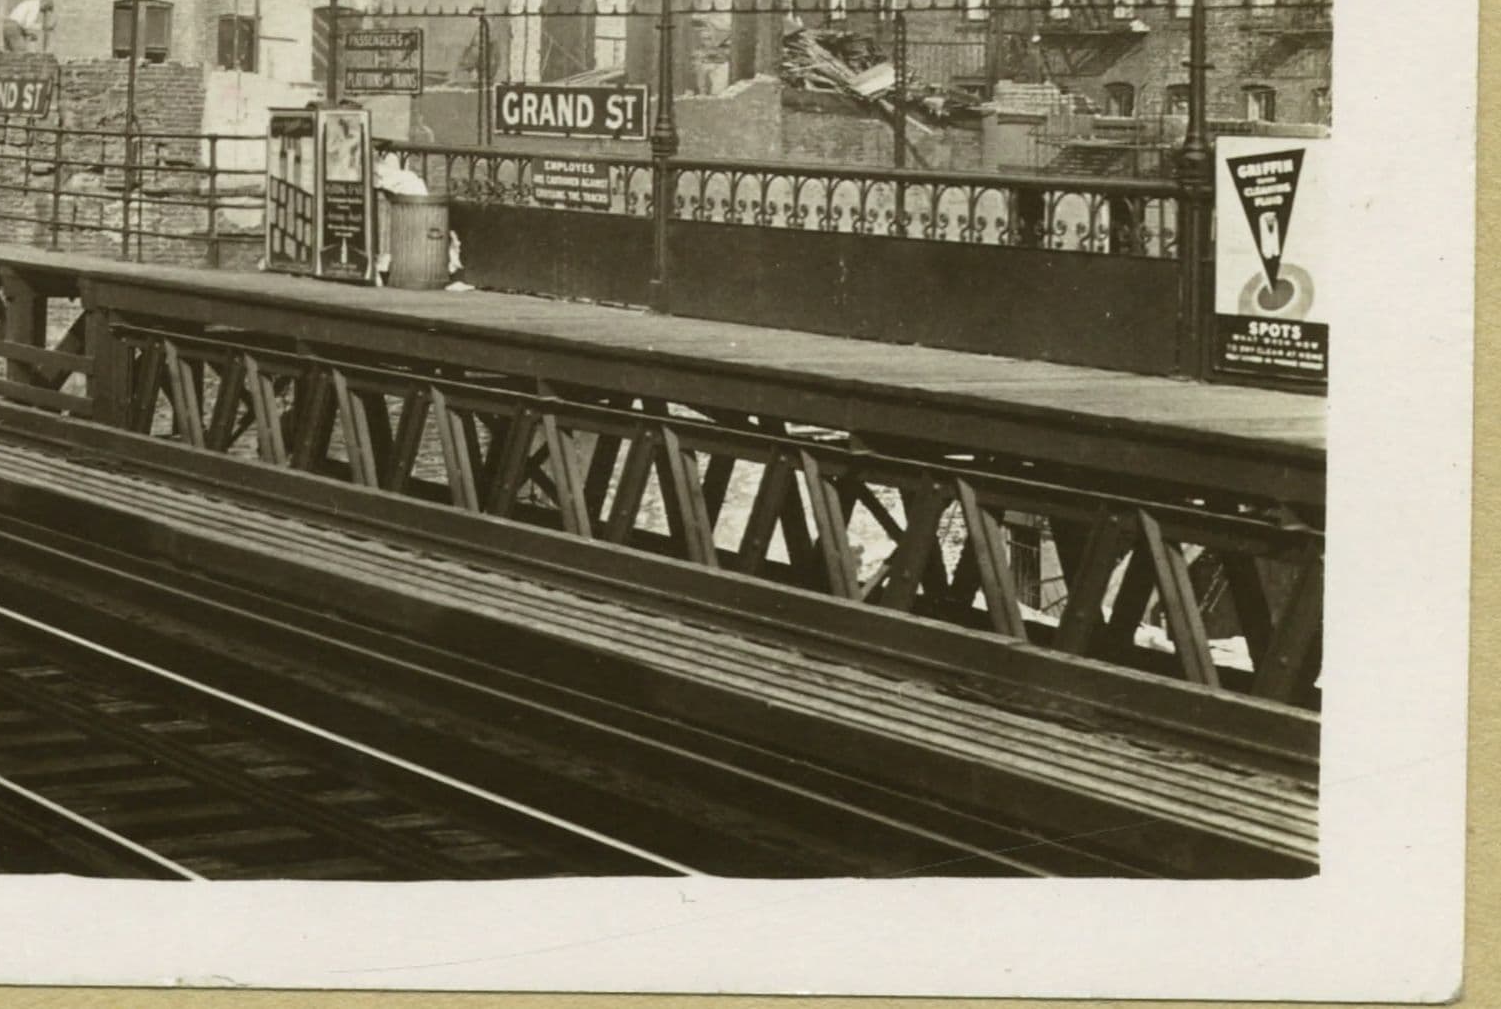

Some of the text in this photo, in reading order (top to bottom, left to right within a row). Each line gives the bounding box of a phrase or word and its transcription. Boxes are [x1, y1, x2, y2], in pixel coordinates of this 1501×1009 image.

[22, 83, 43, 110] ST
[502, 91, 595, 128] GRAND
[544, 160, 595, 174] EMPLOYES
[1237, 159, 1294, 179] GRIFFIN
[1248, 321, 1302, 340] SPOTS
